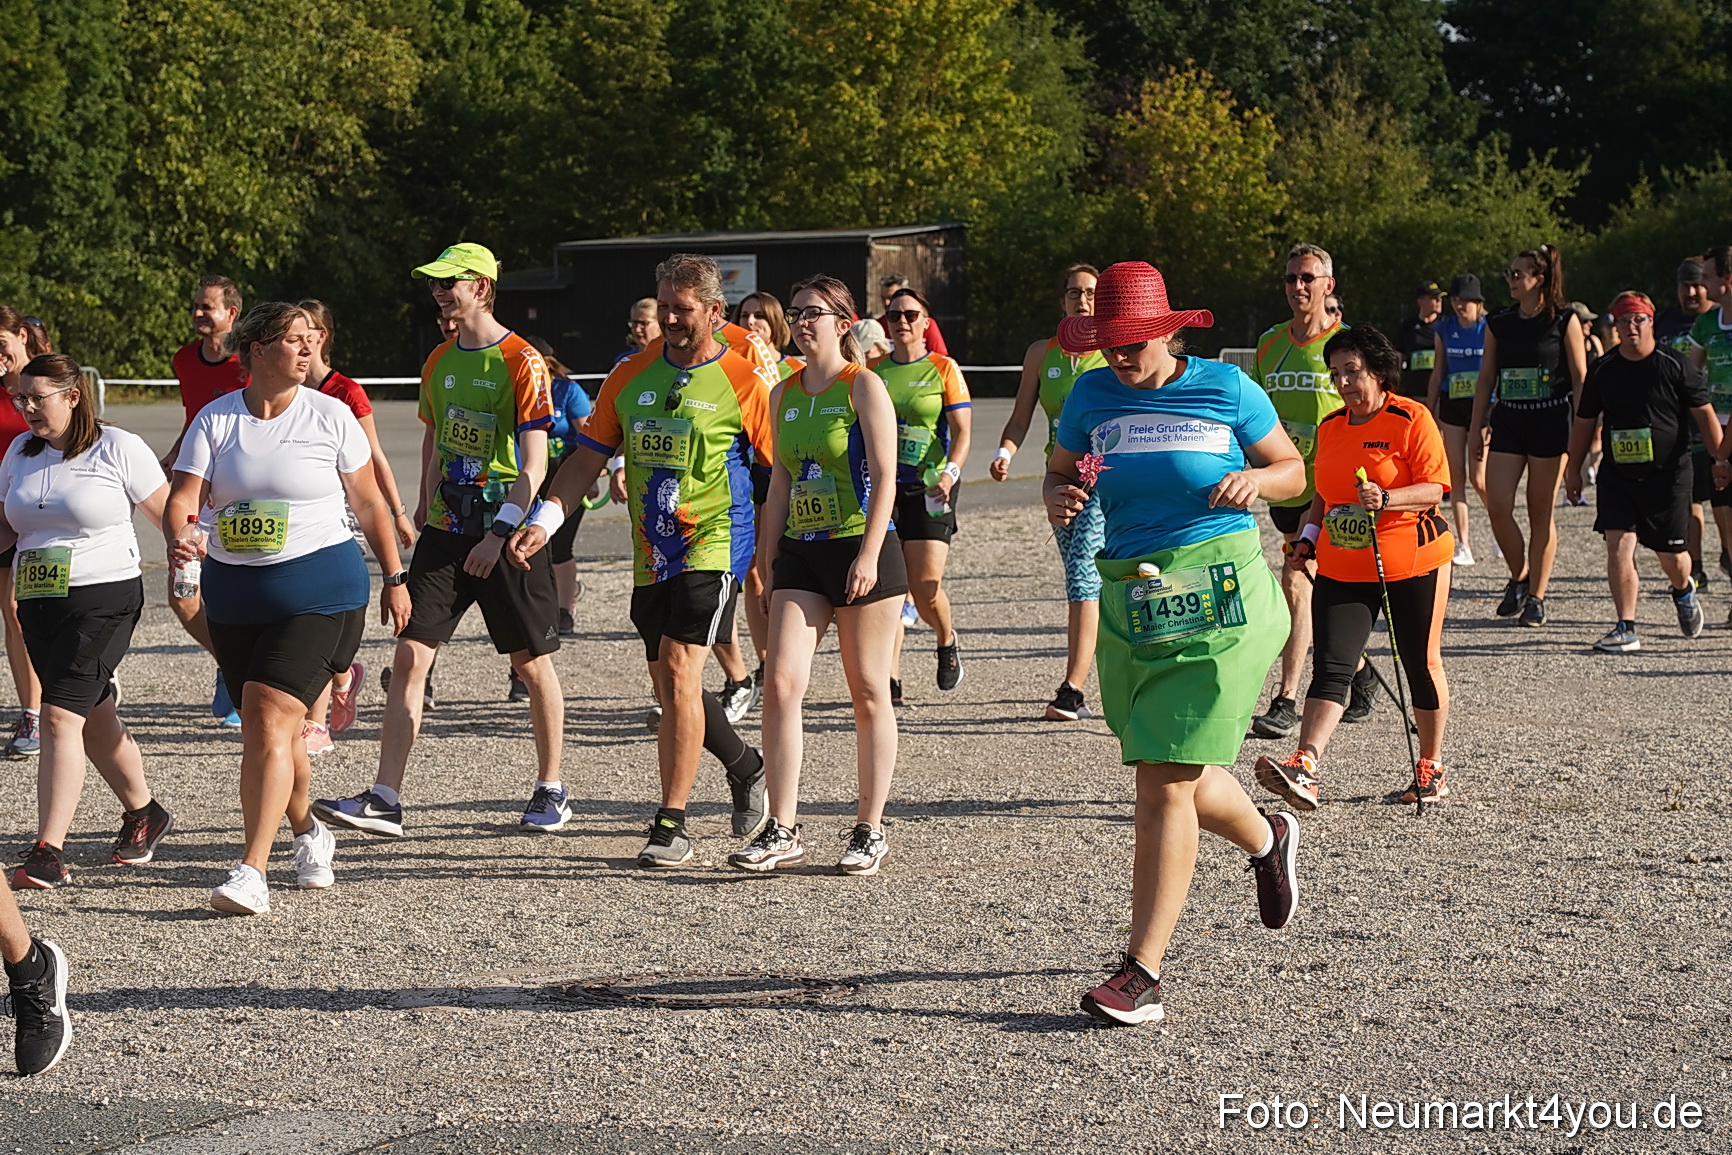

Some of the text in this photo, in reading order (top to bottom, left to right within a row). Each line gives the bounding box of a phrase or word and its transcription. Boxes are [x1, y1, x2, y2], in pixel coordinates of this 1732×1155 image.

[473, 379, 497, 390] BOCK
[1265, 371, 1337, 395] BOCK
[1508, 379, 1528, 390] 263
[685, 398, 718, 412] BOCK
[820, 406, 848, 415] BOCK
[452, 422, 479, 444] 635
[1128, 422, 1220, 434] Freie Grundschule
[484, 433, 492, 455] 2022
[642, 434, 674, 452] 636
[1140, 435, 1160, 444] Haus
[1162, 434, 1172, 443] St.
[1174, 434, 1204, 442] Marien
[1363, 441, 1390, 450] THULE
[1620, 440, 1640, 453] 301
[678, 440, 687, 462] 2022
[796, 497, 822, 517] 616
[828, 497, 838, 522] 2022
[229, 518, 276, 536] 1893
[276, 522, 284, 546] 2022
[1332, 518, 1367, 536] 1406
[22, 564, 59, 582] 1894
[59, 568, 67, 590] 2022
[1140, 592, 1200, 622] 1439
[1201, 593, 1215, 622] 2022
[1132, 610, 1142, 634] RUN
[1143, 622, 1166, 632] Maier
[1168, 616, 1205, 628] Christina
